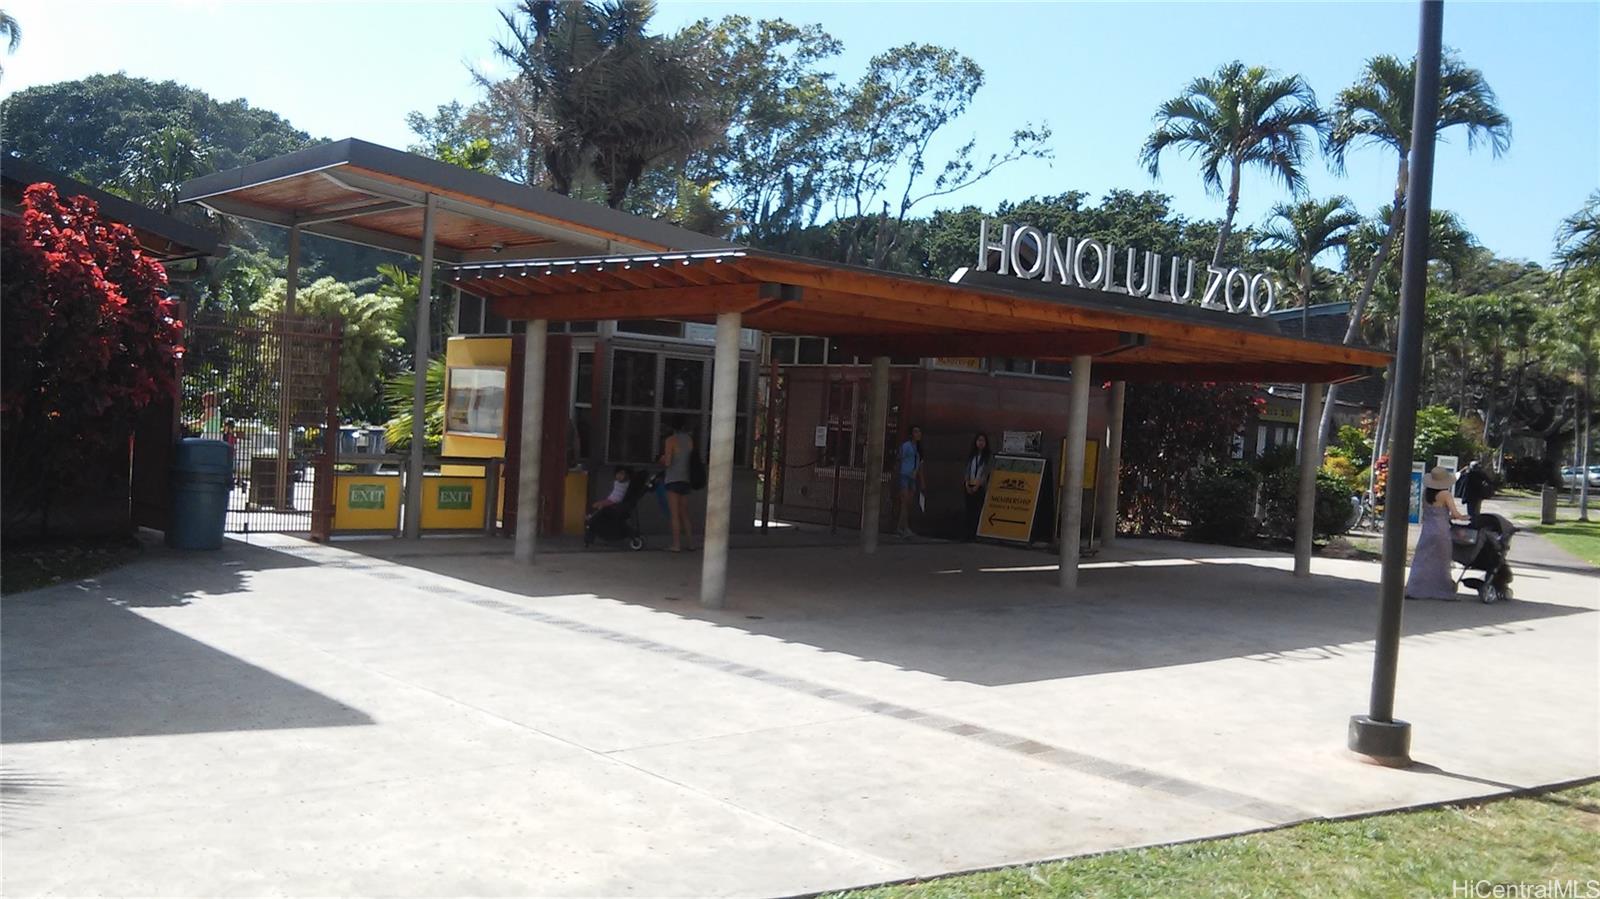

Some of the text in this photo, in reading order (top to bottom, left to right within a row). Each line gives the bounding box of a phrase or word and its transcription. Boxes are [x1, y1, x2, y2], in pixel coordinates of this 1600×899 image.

[976, 219, 1275, 317] HONOLULU ZOO
[350, 489, 384, 503] EXIT
[439, 491, 472, 503] EXIT
[991, 495, 1032, 505] MEMBERSHIP
